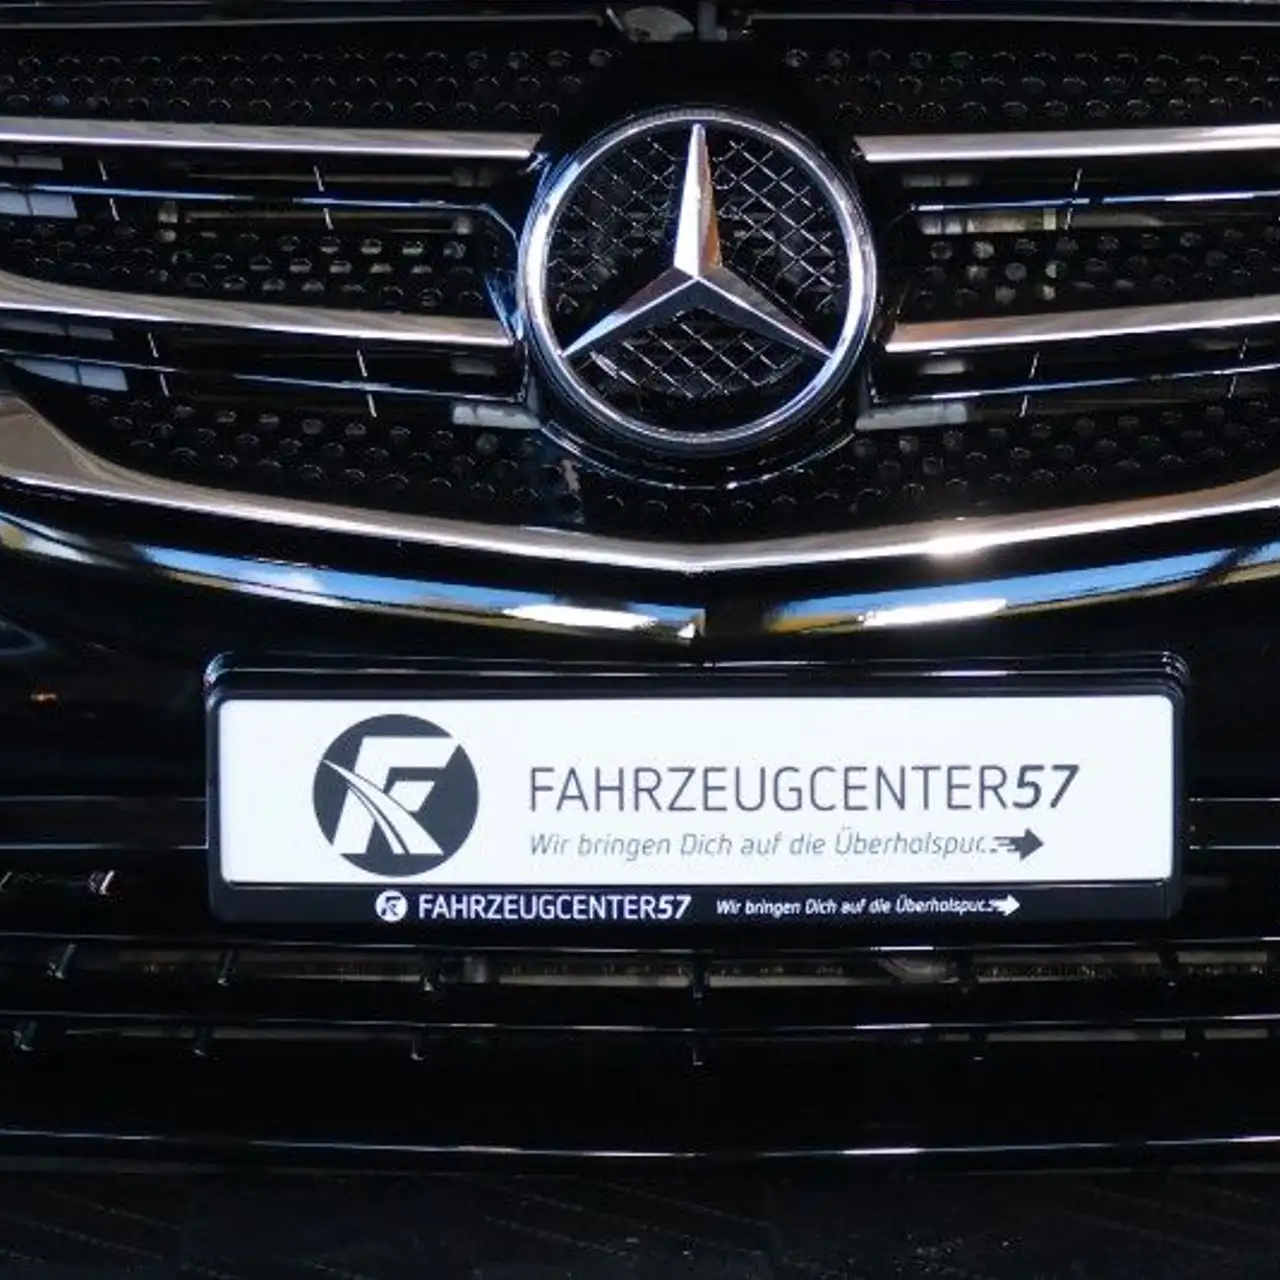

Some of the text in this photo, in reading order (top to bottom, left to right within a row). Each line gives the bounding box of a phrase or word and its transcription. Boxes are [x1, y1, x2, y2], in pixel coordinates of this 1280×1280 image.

[530, 763, 1081, 813] FAHRZEUGCENTER57
[531, 833, 570, 856] Wir
[578, 833, 671, 862] bringen
[680, 832, 732, 857] Dich
[740, 832, 782, 856] auf
[789, 832, 826, 856] die
[419, 894, 692, 920] FAHRZEUGCENTER57
[716, 898, 741, 915] Wir
[745, 898, 802, 919] bringen
[805, 898, 837, 915] Dich
[841, 898, 866, 914] auf
[869, 898, 891, 914] die
